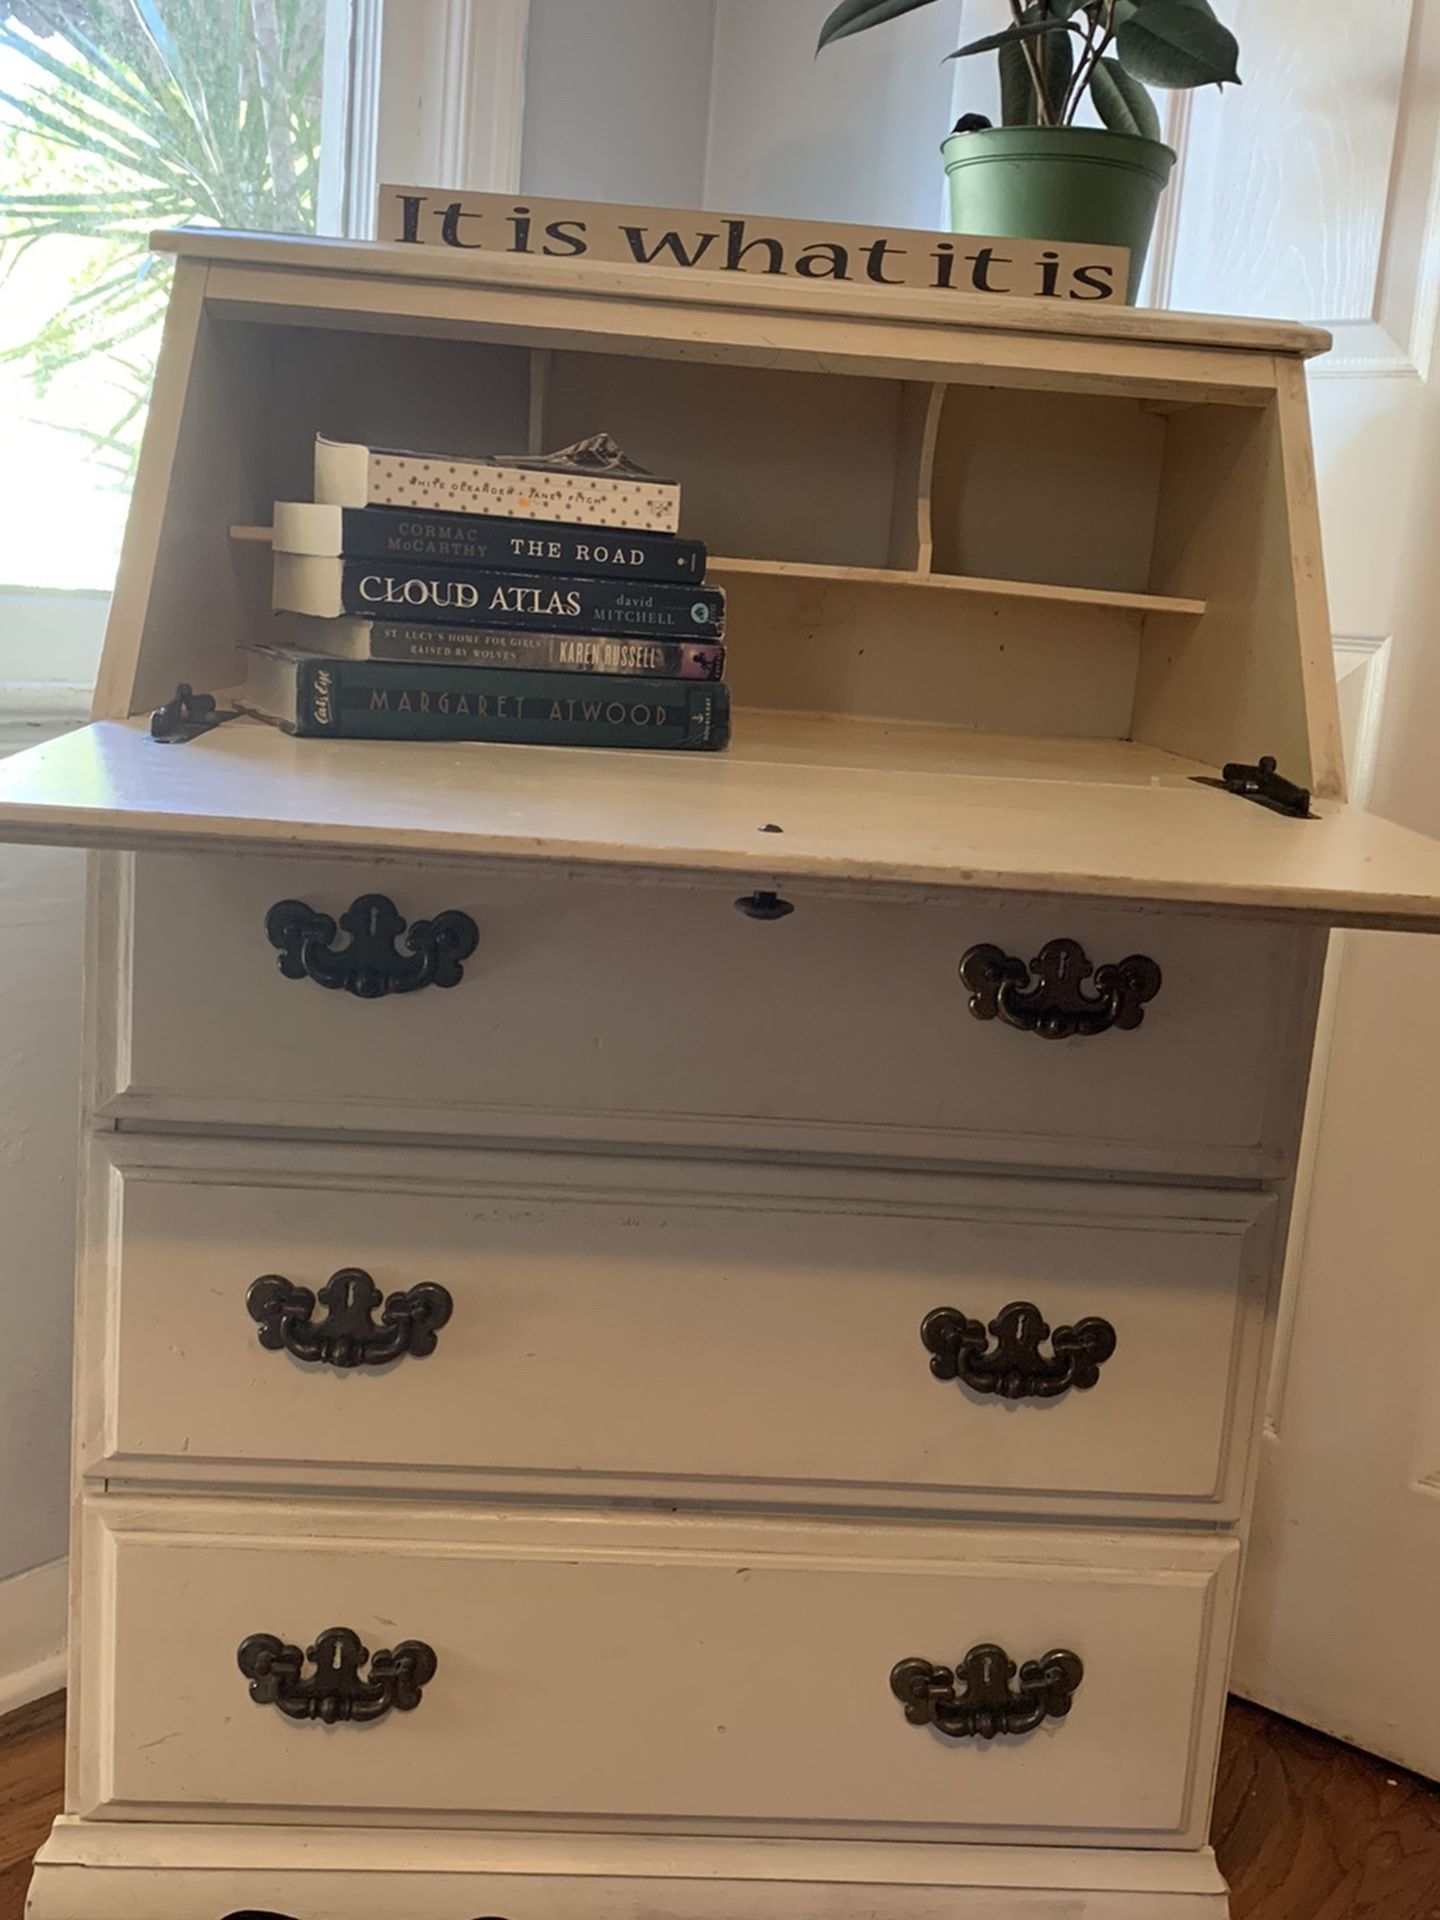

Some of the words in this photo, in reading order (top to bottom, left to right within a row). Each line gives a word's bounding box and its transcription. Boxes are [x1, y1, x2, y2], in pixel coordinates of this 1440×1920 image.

[394, 194, 482, 249] It
[506, 207, 588, 257] is
[618, 219, 907, 285] what
[929, 242, 1013, 294] it
[1034, 251, 1114, 301] is
[398, 522, 478, 541] CORMAC
[510, 538, 562, 560] THE
[576, 545, 646, 566] ROAD
[359, 574, 480, 609] CLOUD
[487, 585, 582, 617] ATLAS
[616, 594, 654, 608] david
[593, 608, 676, 626] MITCHELL
[410, 644, 451, 655] RAISED
[455, 647, 470, 657] BY
[472, 648, 518, 660] WOLVES
[448, 634, 481, 645] HOME
[483, 636, 507, 646] FOR
[510, 638, 543, 649] GIRLS
[559, 641, 599, 665] KAREN
[604, 645, 656, 669] RUSSELL
[370, 687, 526, 719] MARGARET
[549, 702, 668, 727] ATWOOD
